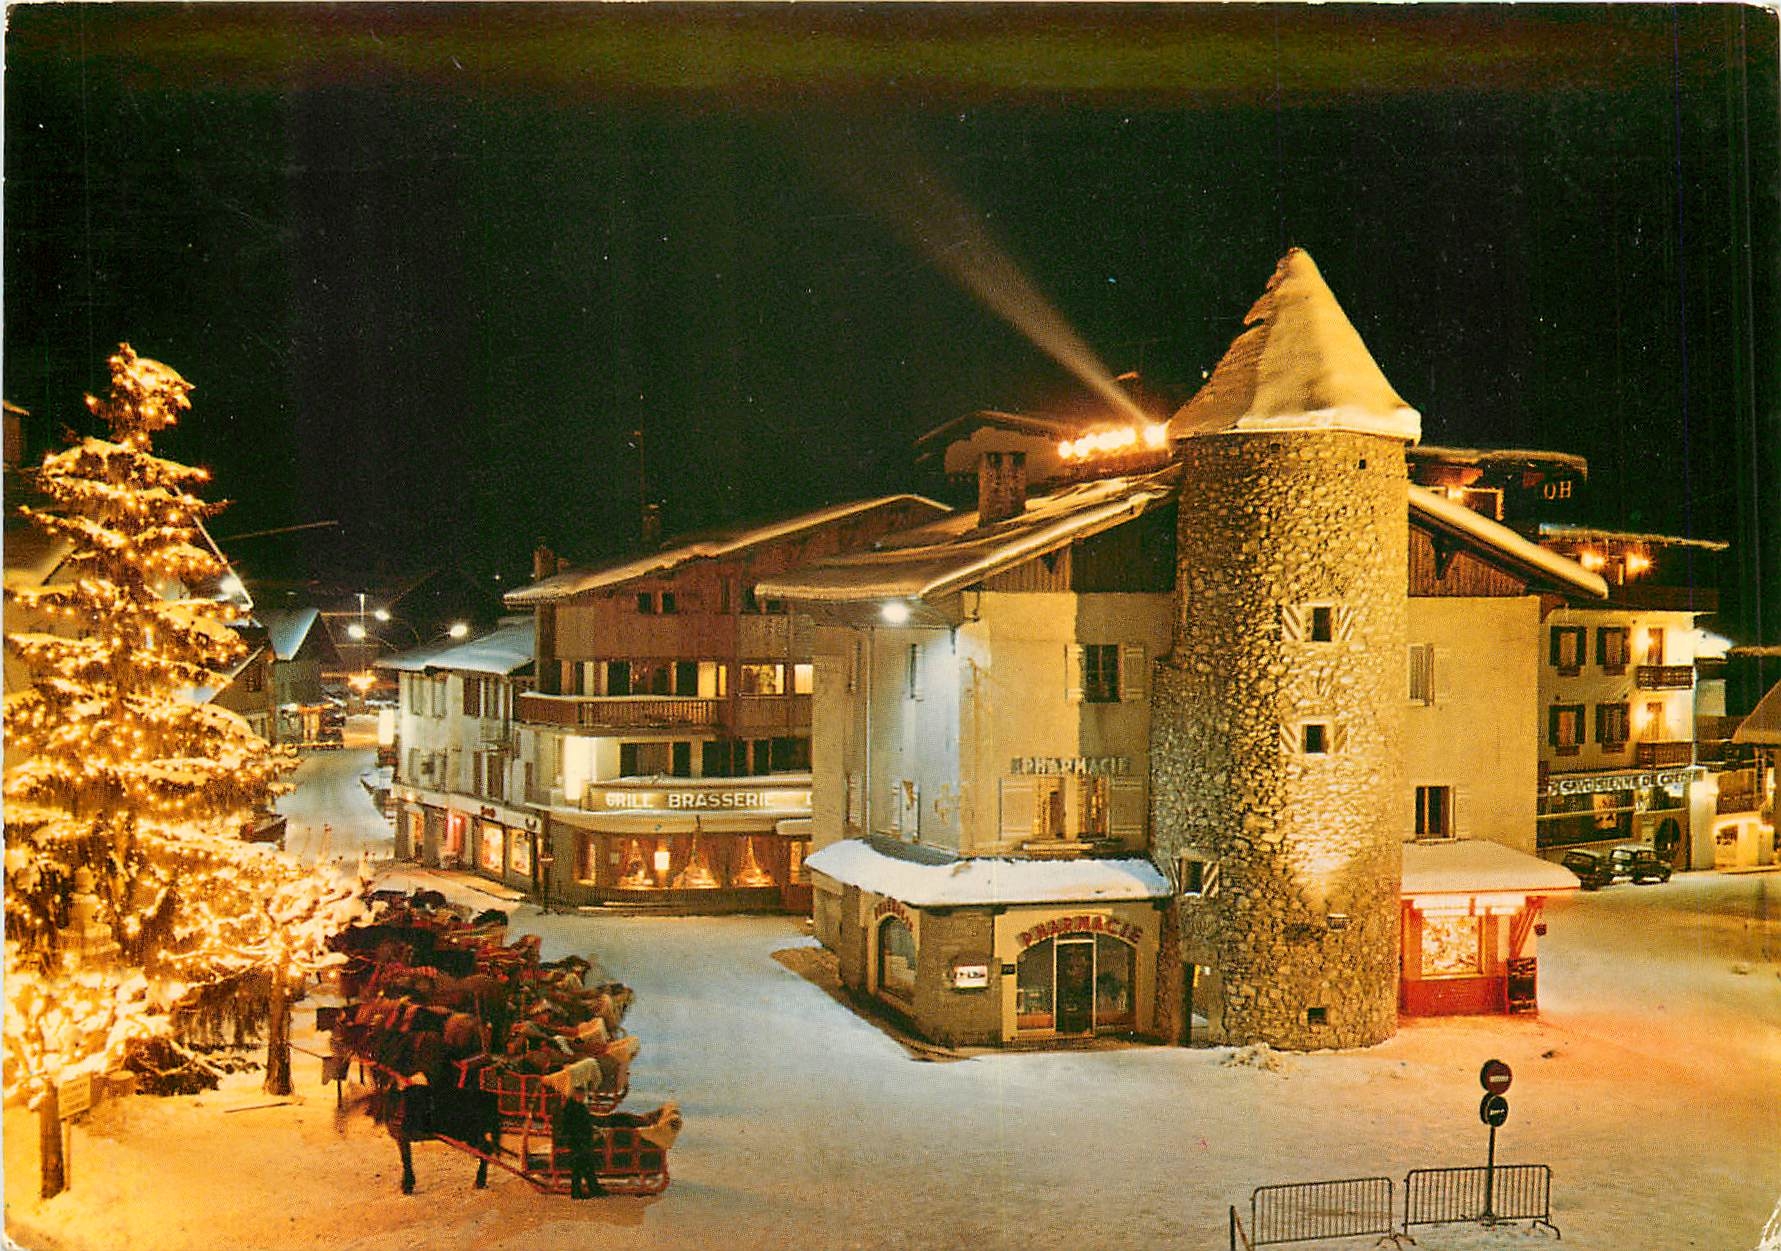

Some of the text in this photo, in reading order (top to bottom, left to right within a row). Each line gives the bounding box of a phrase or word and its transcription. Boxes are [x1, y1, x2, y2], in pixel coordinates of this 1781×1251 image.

[1014, 757, 1131, 774] PHARMACIE
[605, 793, 772, 808] GRILL BRASSERIE
[1020, 915, 1143, 947] PHARMACIE
